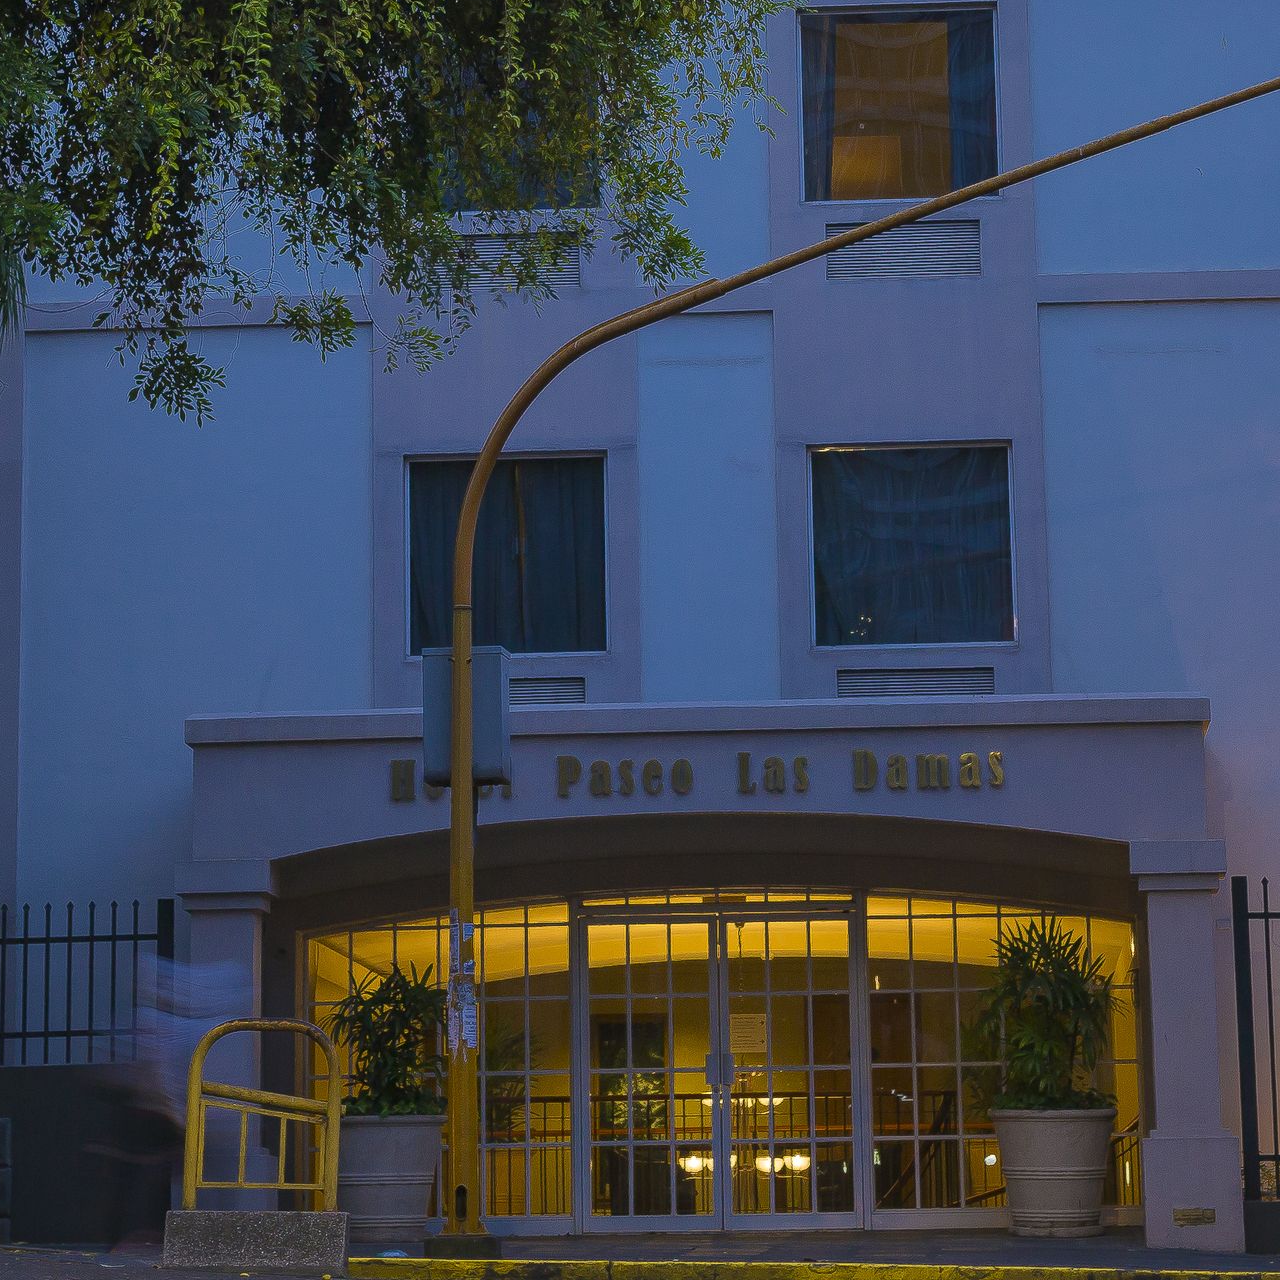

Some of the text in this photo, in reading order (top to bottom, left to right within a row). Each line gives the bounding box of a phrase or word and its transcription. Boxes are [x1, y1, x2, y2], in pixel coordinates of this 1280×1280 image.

[557, 755, 694, 798] Paseo
[737, 751, 811, 795] Las
[852, 749, 1005, 791] Damas
